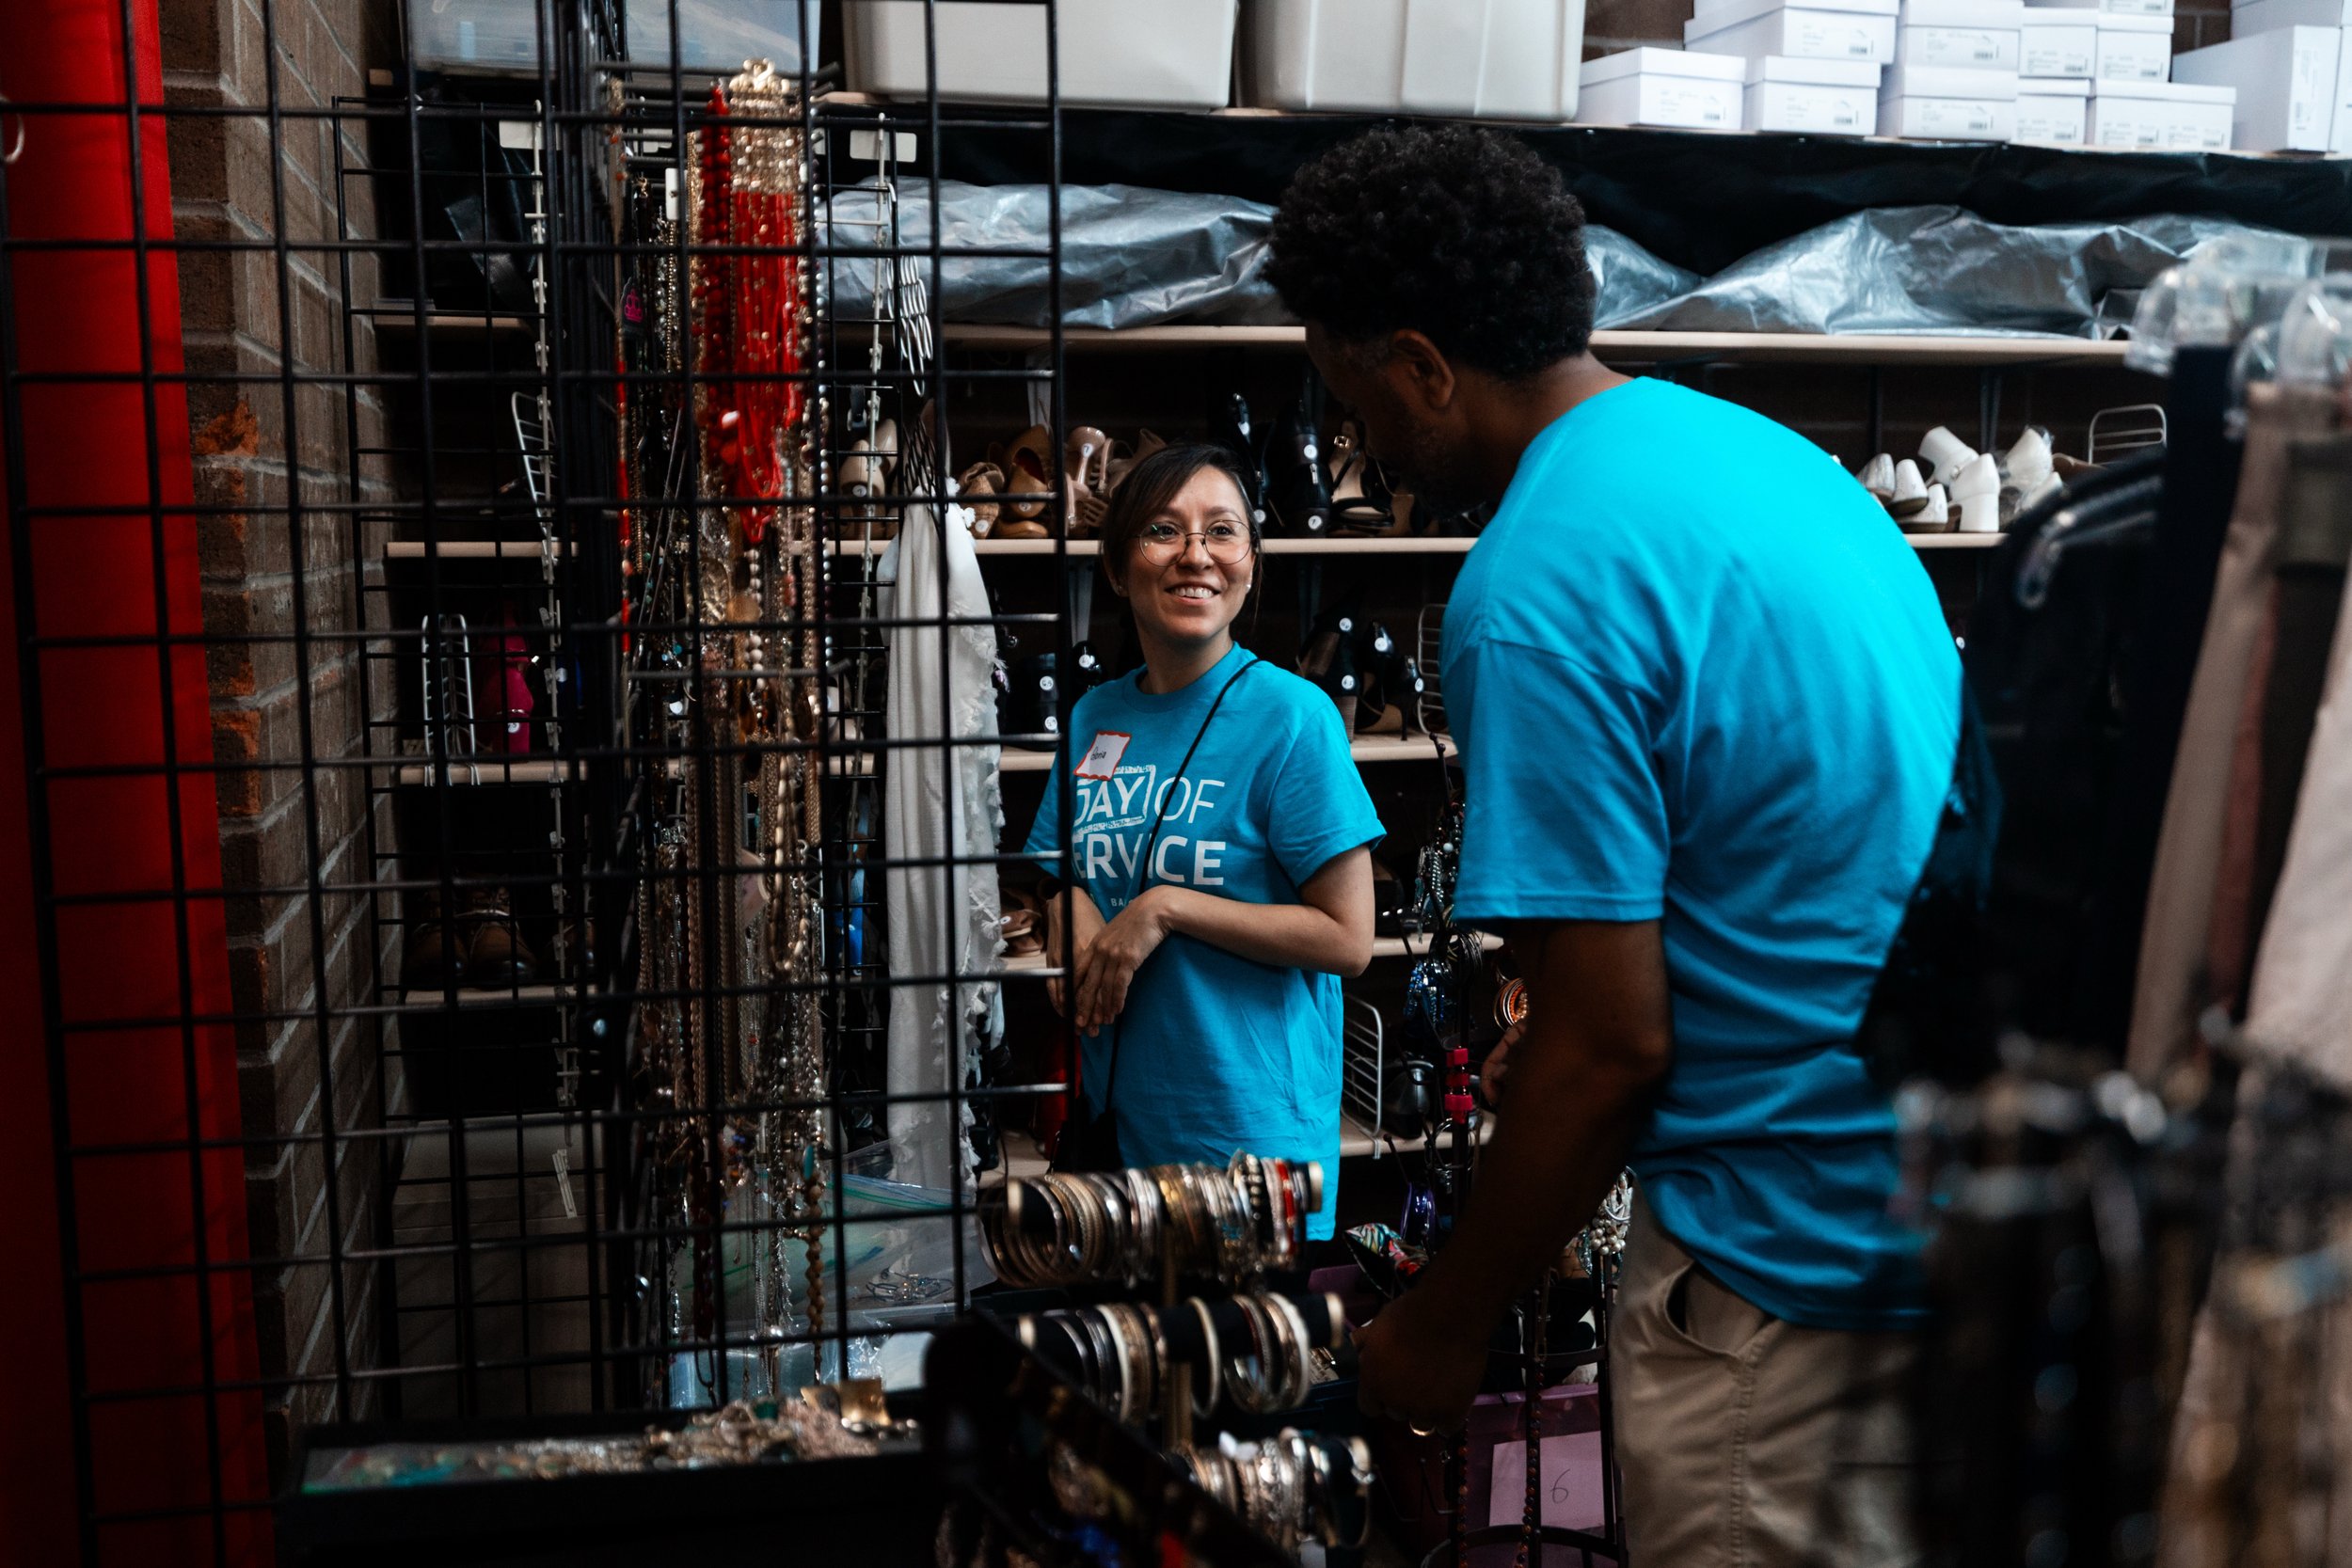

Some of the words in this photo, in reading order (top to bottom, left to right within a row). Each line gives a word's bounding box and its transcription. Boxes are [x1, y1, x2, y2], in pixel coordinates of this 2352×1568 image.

[1154, 777, 1225, 823] OF
[1072, 832, 1226, 886] ERVICE
[1550, 1468, 1571, 1504] 6
